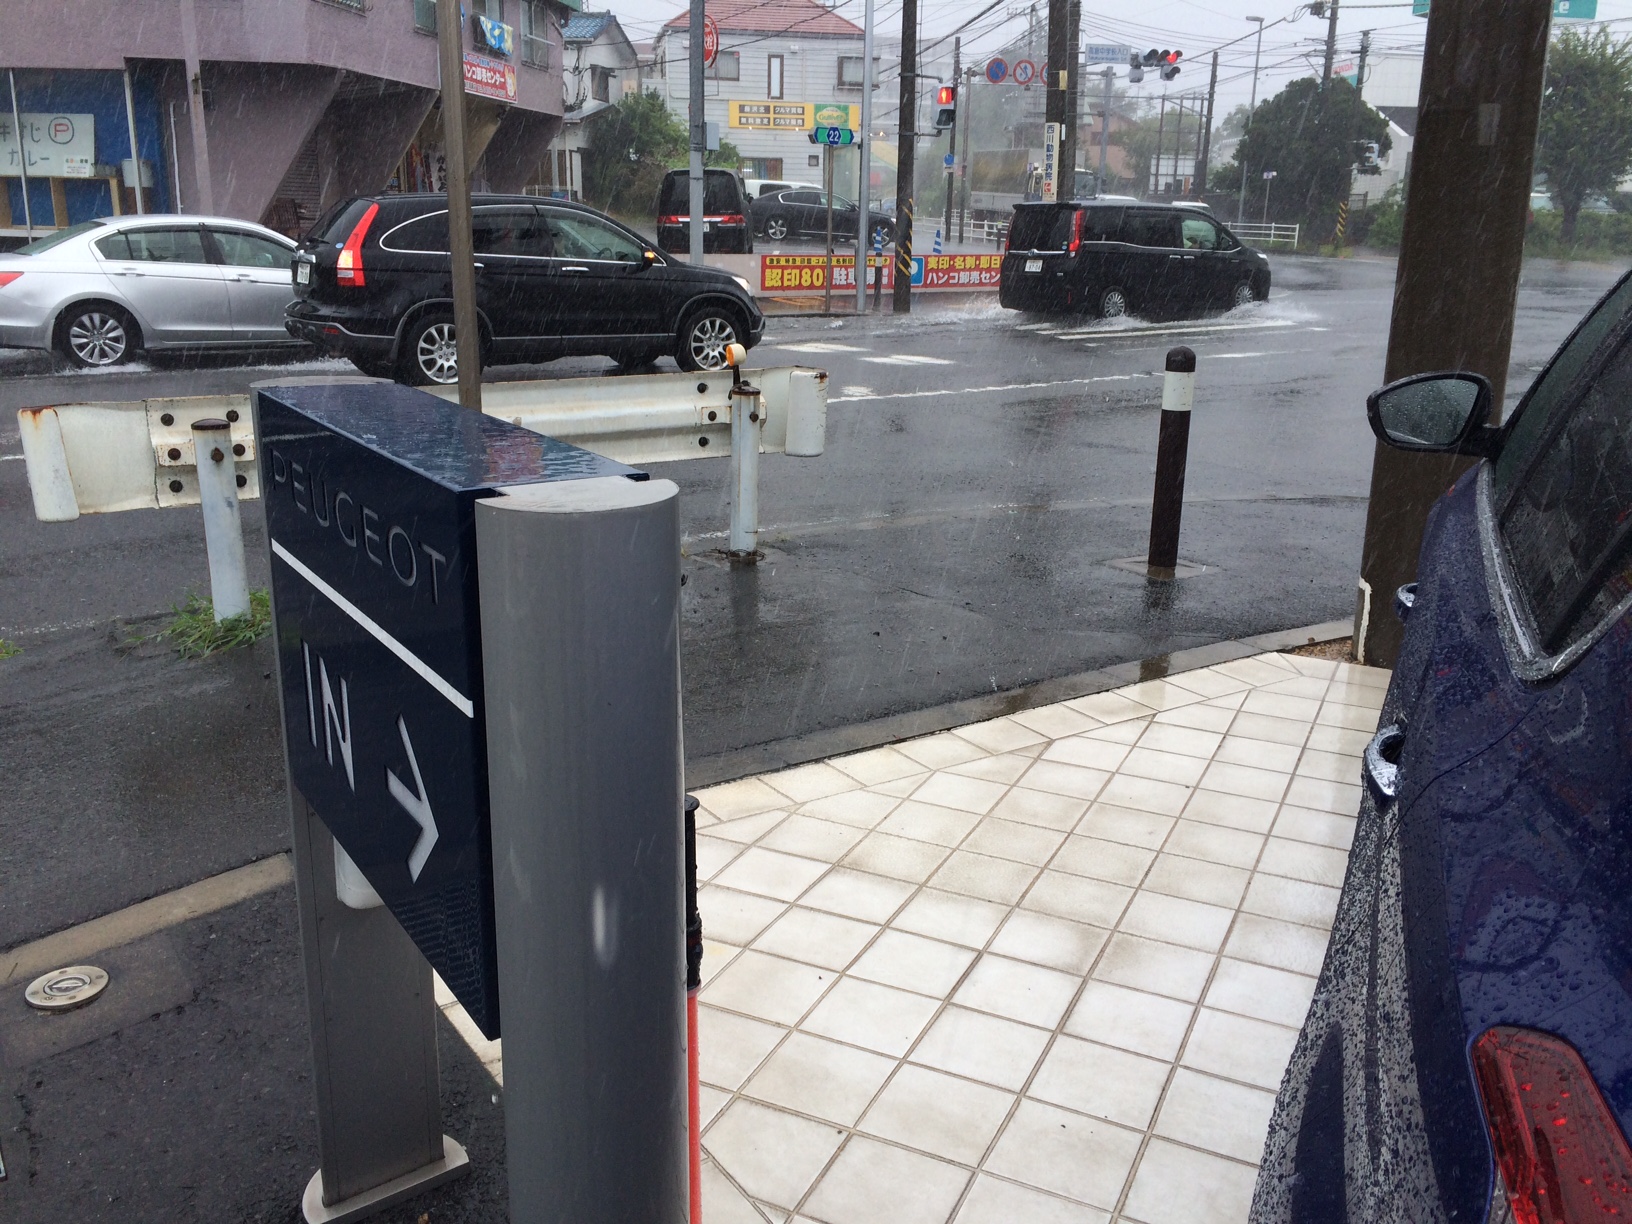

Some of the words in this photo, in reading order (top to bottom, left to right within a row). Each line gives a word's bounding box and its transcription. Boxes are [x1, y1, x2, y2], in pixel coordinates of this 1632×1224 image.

[828, 130, 840, 142] 22
[270, 448, 447, 605] PEUGEOT
[301, 637, 356, 795] IN
